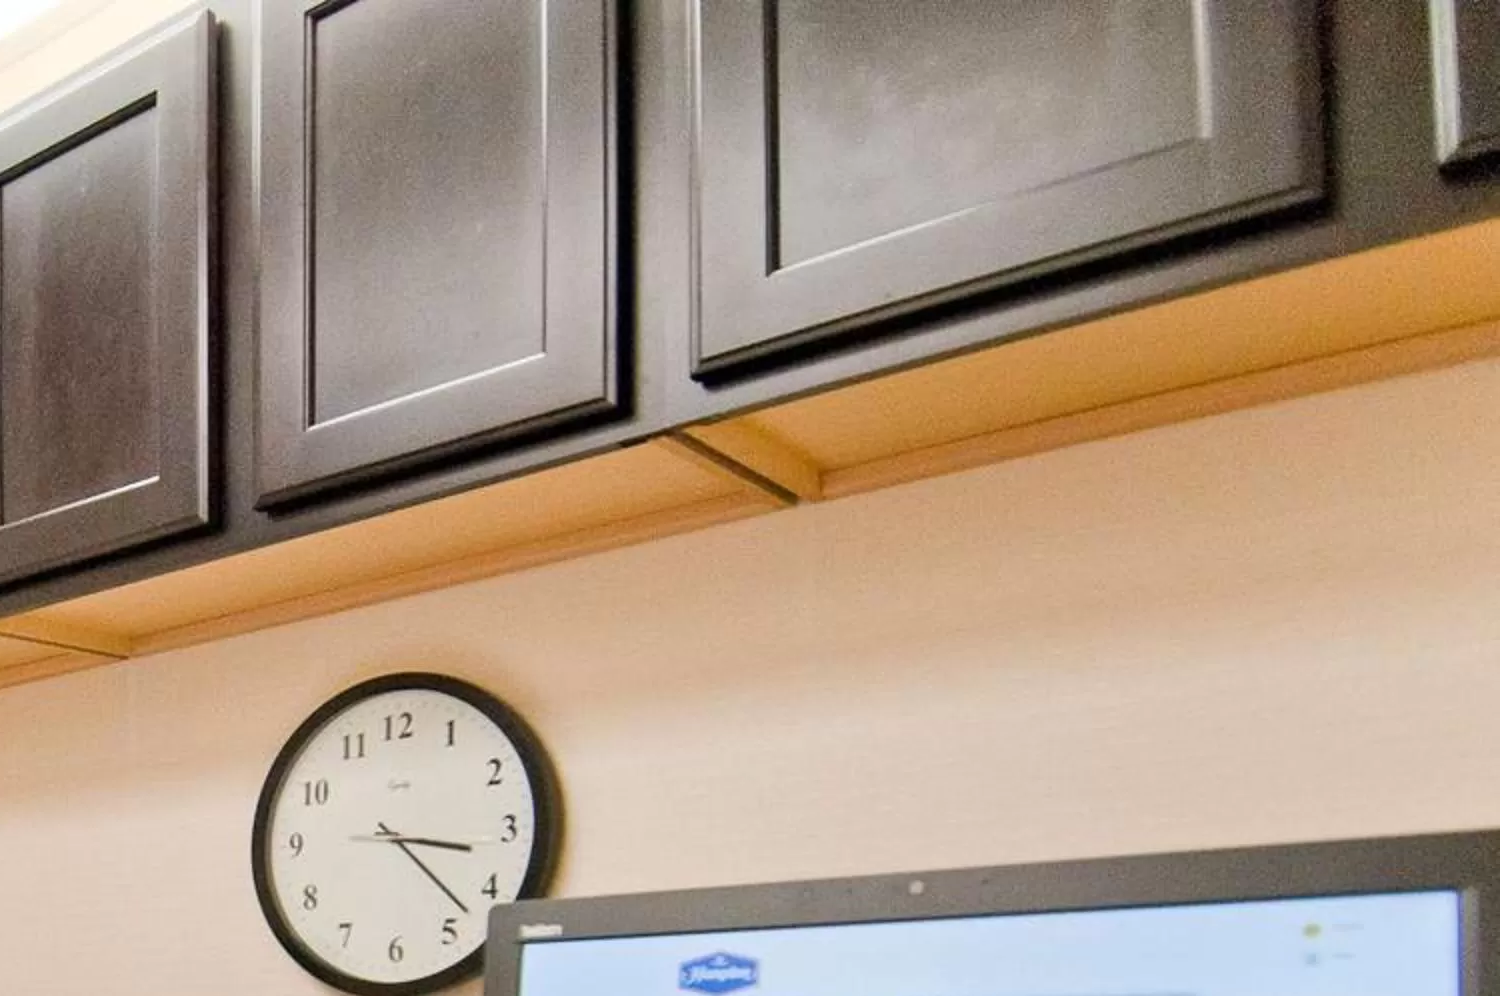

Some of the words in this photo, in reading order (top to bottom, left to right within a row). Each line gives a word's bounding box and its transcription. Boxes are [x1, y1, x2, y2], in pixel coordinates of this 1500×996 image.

[384, 712, 413, 742] 12
[446, 719, 456, 747] 1
[343, 733, 365, 761] 11
[486, 757, 503, 787] 2
[304, 780, 329, 807] 10
[500, 813, 518, 843] 3
[289, 833, 304, 857] 9
[302, 885, 318, 911] 8
[480, 872, 499, 900] 4
[338, 922, 353, 948] 7
[441, 917, 458, 945] 5
[388, 937, 404, 963] 6
